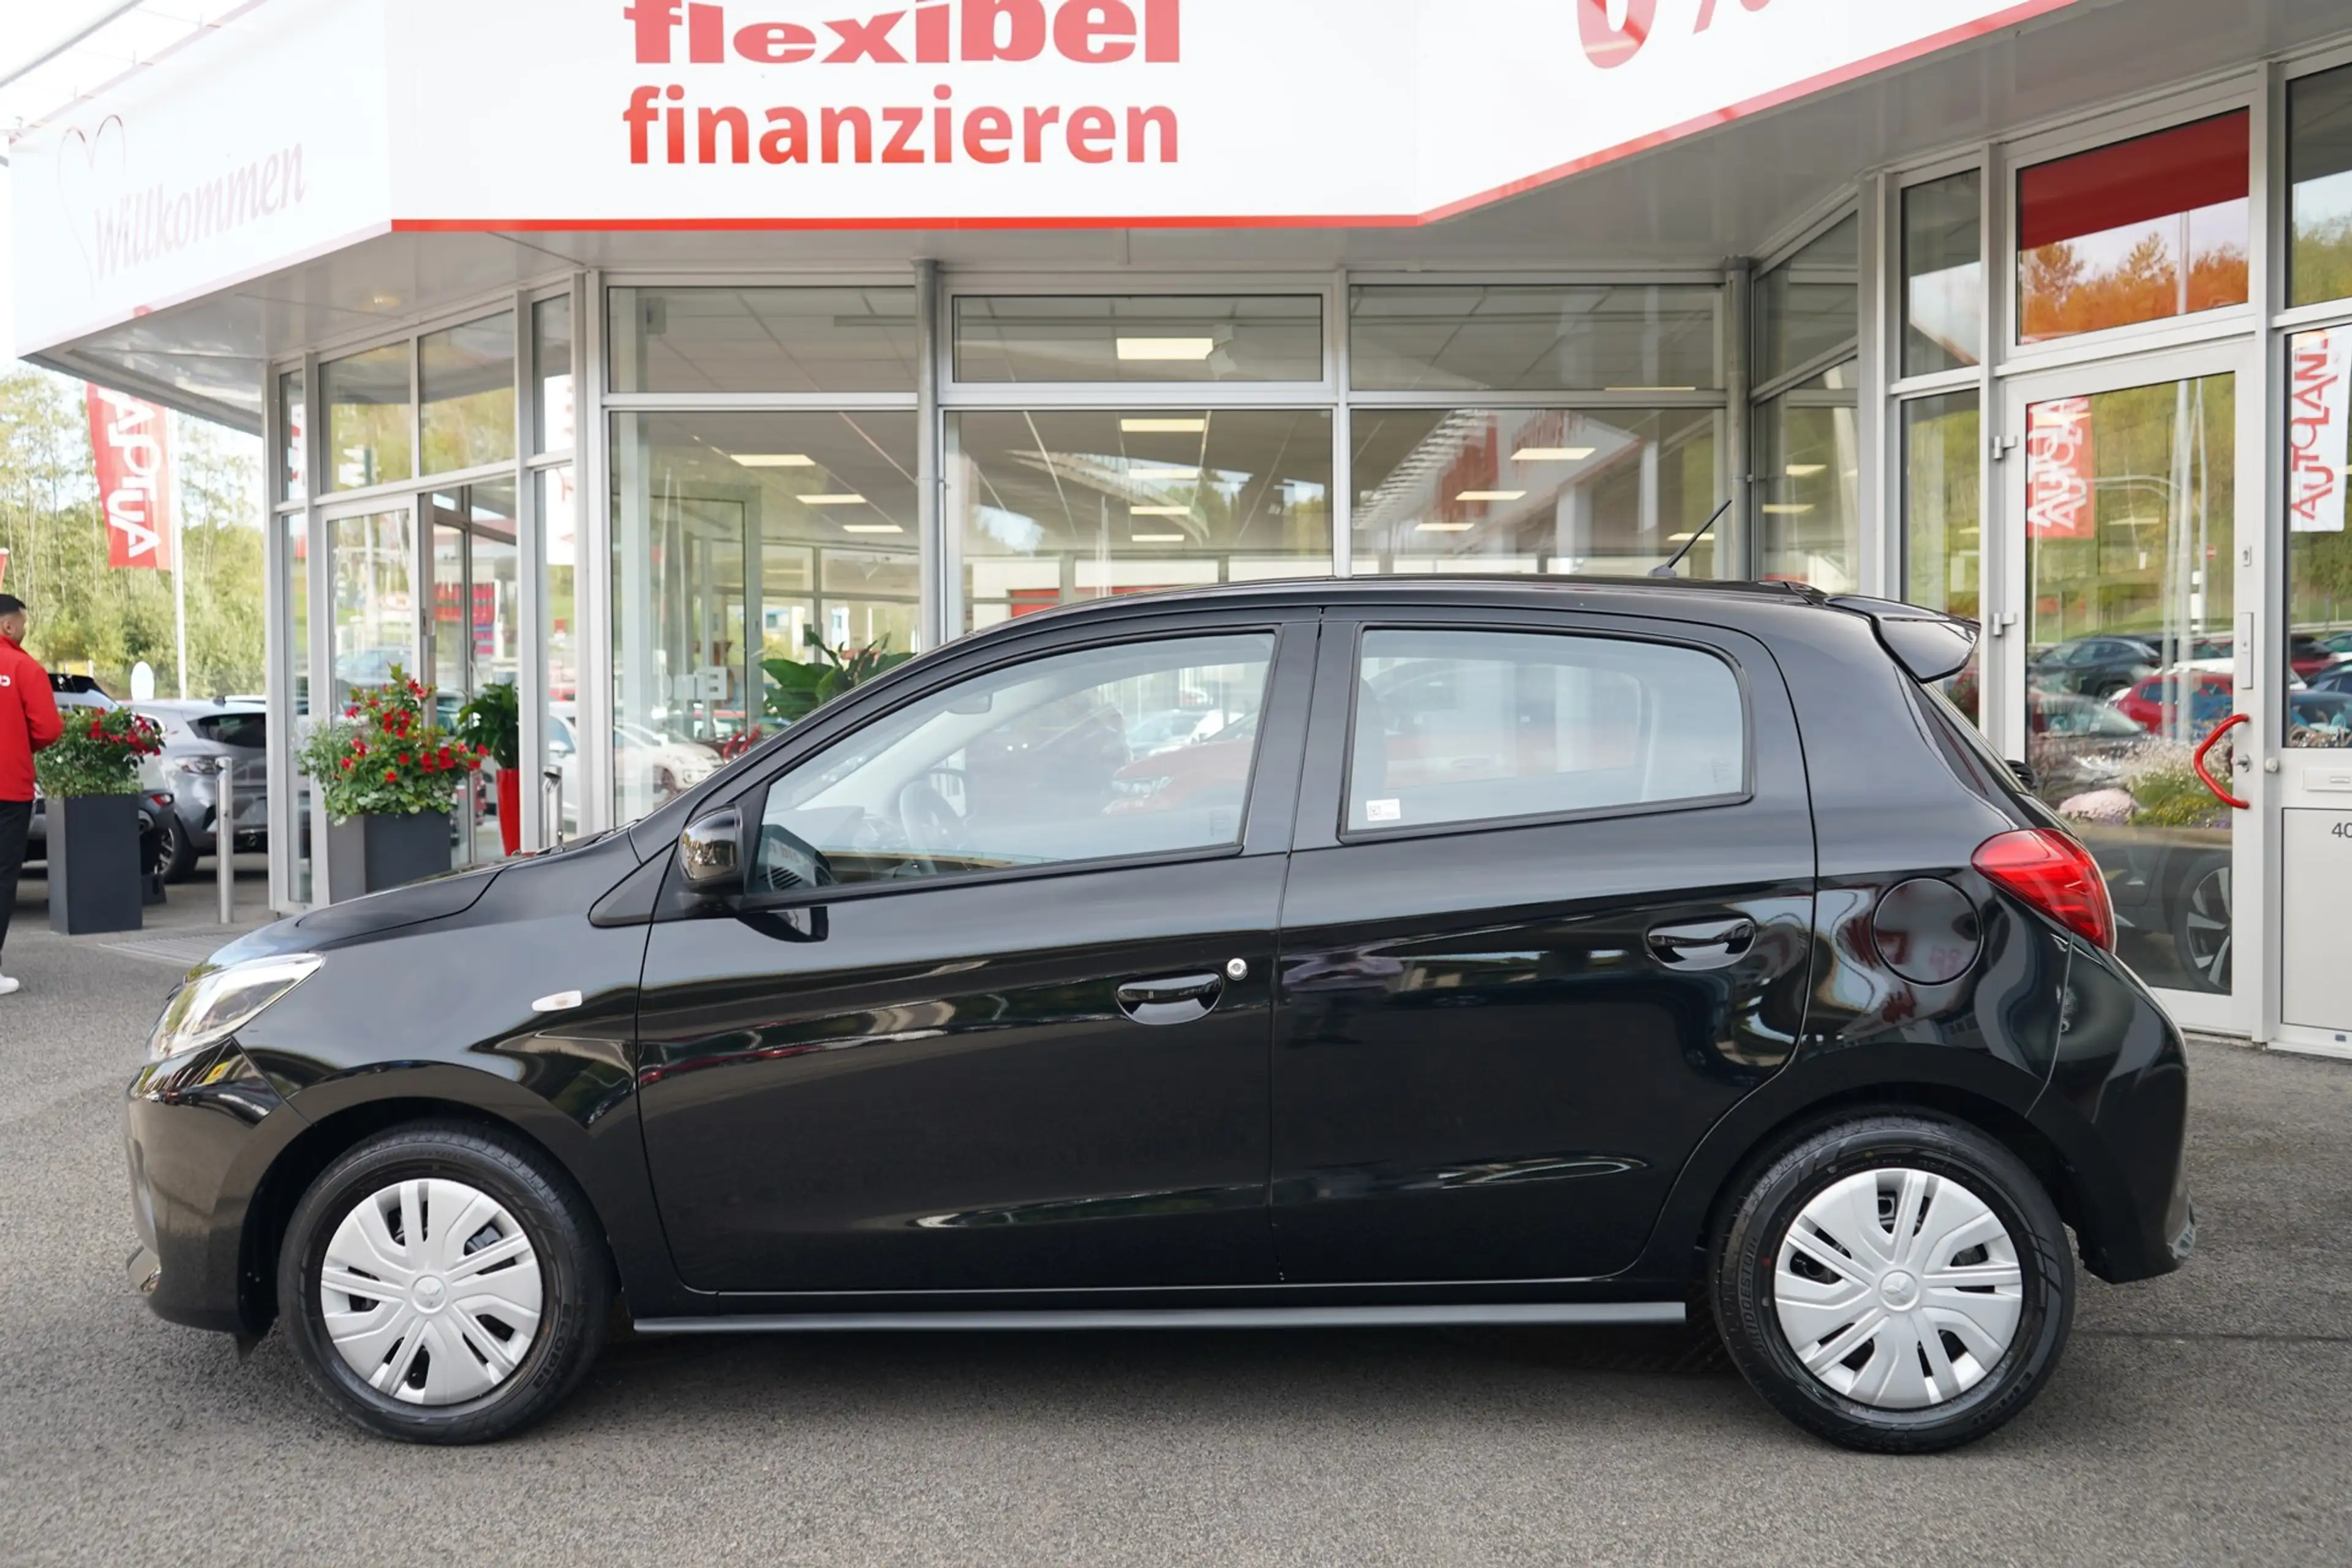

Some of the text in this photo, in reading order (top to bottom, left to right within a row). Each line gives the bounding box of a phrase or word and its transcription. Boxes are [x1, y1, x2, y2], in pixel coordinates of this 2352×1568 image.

[624, 0, 1180, 64] flexibel
[622, 85, 1178, 165] finanzieren
[94, 142, 306, 281] Willkommen
[2290, 337, 2339, 521] AUTOLAN
